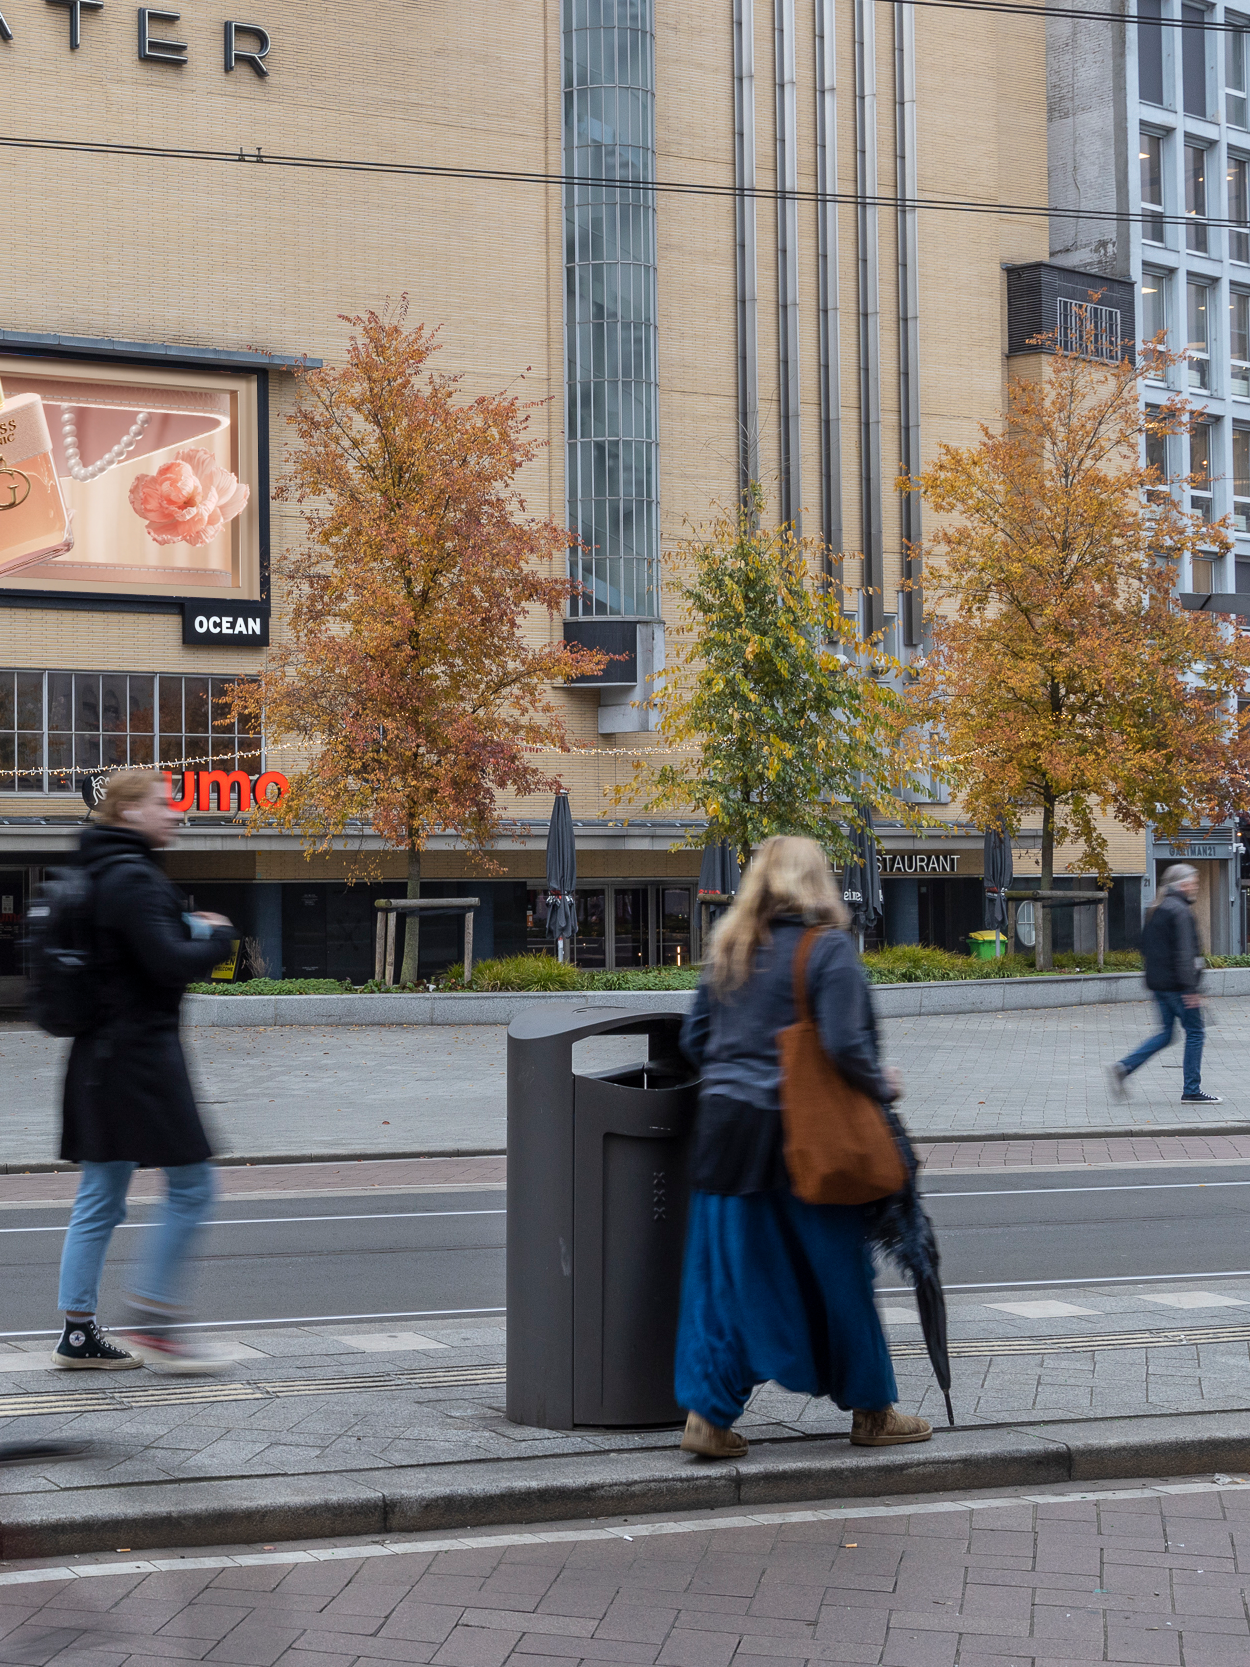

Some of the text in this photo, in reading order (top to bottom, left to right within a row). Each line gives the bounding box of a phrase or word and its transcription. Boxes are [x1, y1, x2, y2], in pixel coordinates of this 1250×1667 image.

[194, 615, 261, 635] OCEAN
[160, 769, 291, 812] umo
[875, 855, 961, 873] STAURANT
